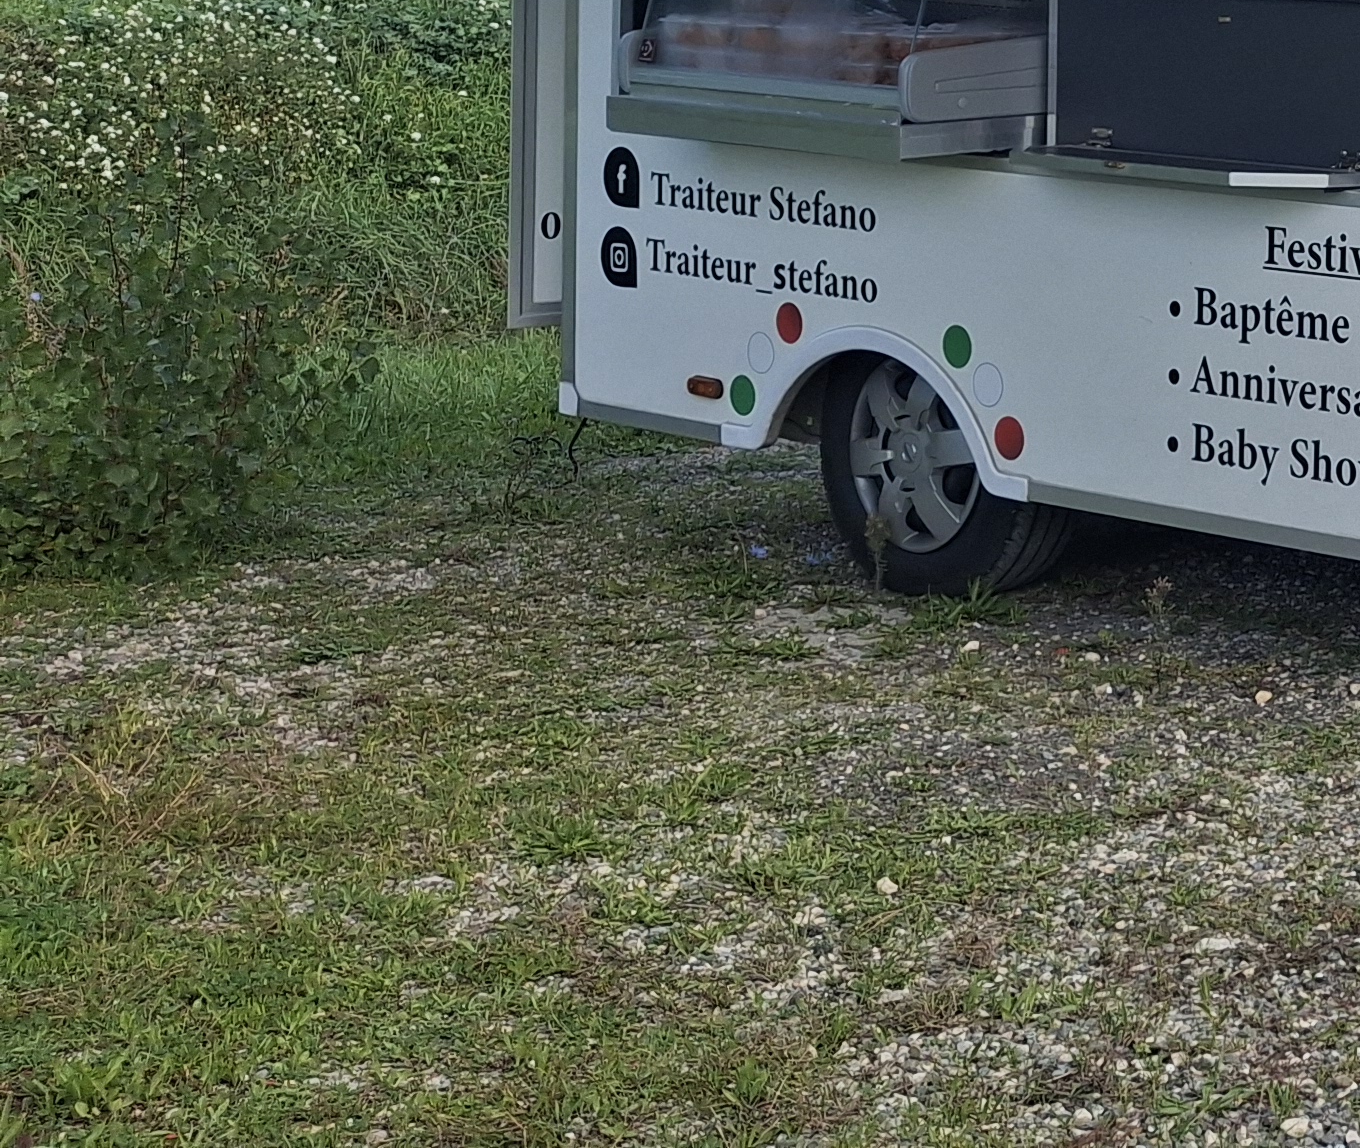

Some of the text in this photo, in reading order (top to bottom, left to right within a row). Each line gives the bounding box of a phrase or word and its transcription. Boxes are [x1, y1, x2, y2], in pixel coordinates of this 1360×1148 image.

[651, 171, 876, 232] Traiteur Stefano
[646, 238, 878, 303] Traiteur_stefano
[1193, 286, 1350, 345] Baptême
[1191, 423, 1281, 486] Baby
